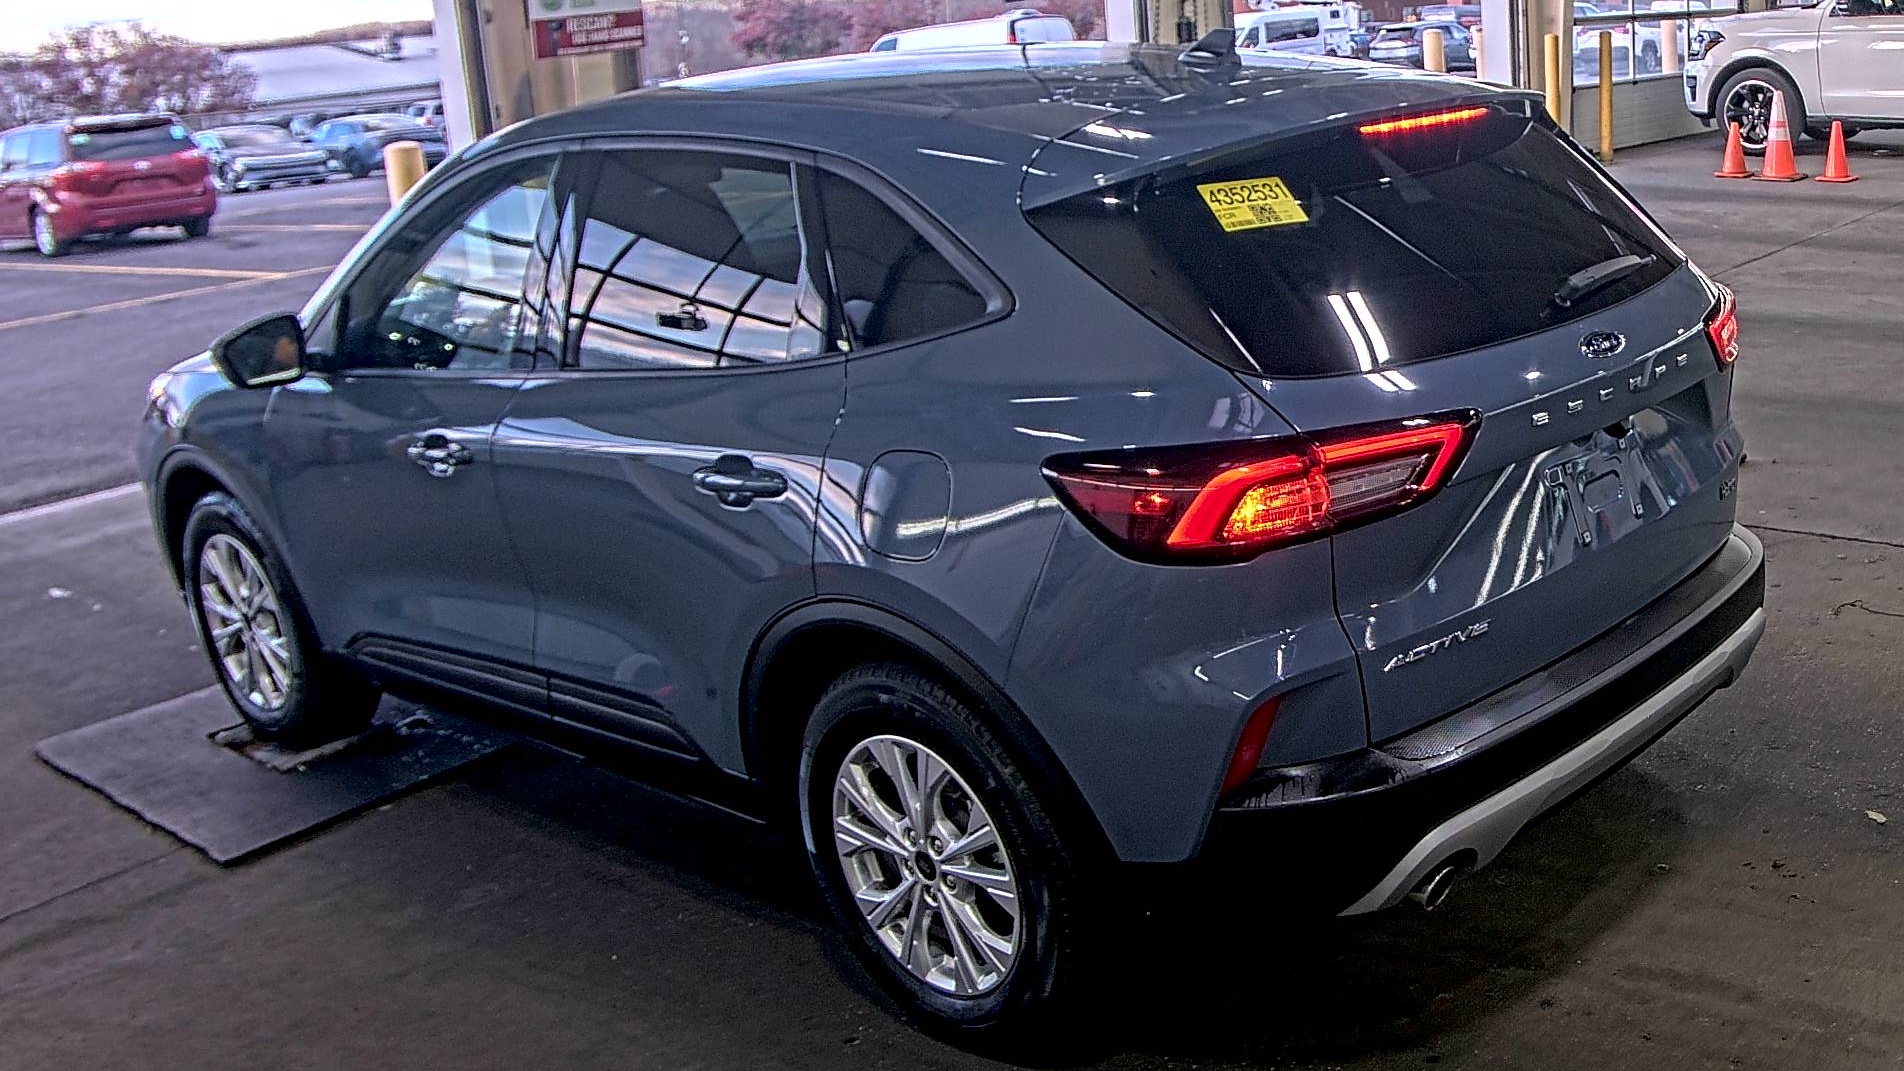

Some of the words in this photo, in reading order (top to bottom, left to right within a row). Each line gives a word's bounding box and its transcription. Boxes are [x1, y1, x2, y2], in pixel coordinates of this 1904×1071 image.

[1209, 183, 1288, 206] 4352531
[1532, 353, 1688, 427] ESCAPE
[1383, 618, 1491, 672] ACTIVE
